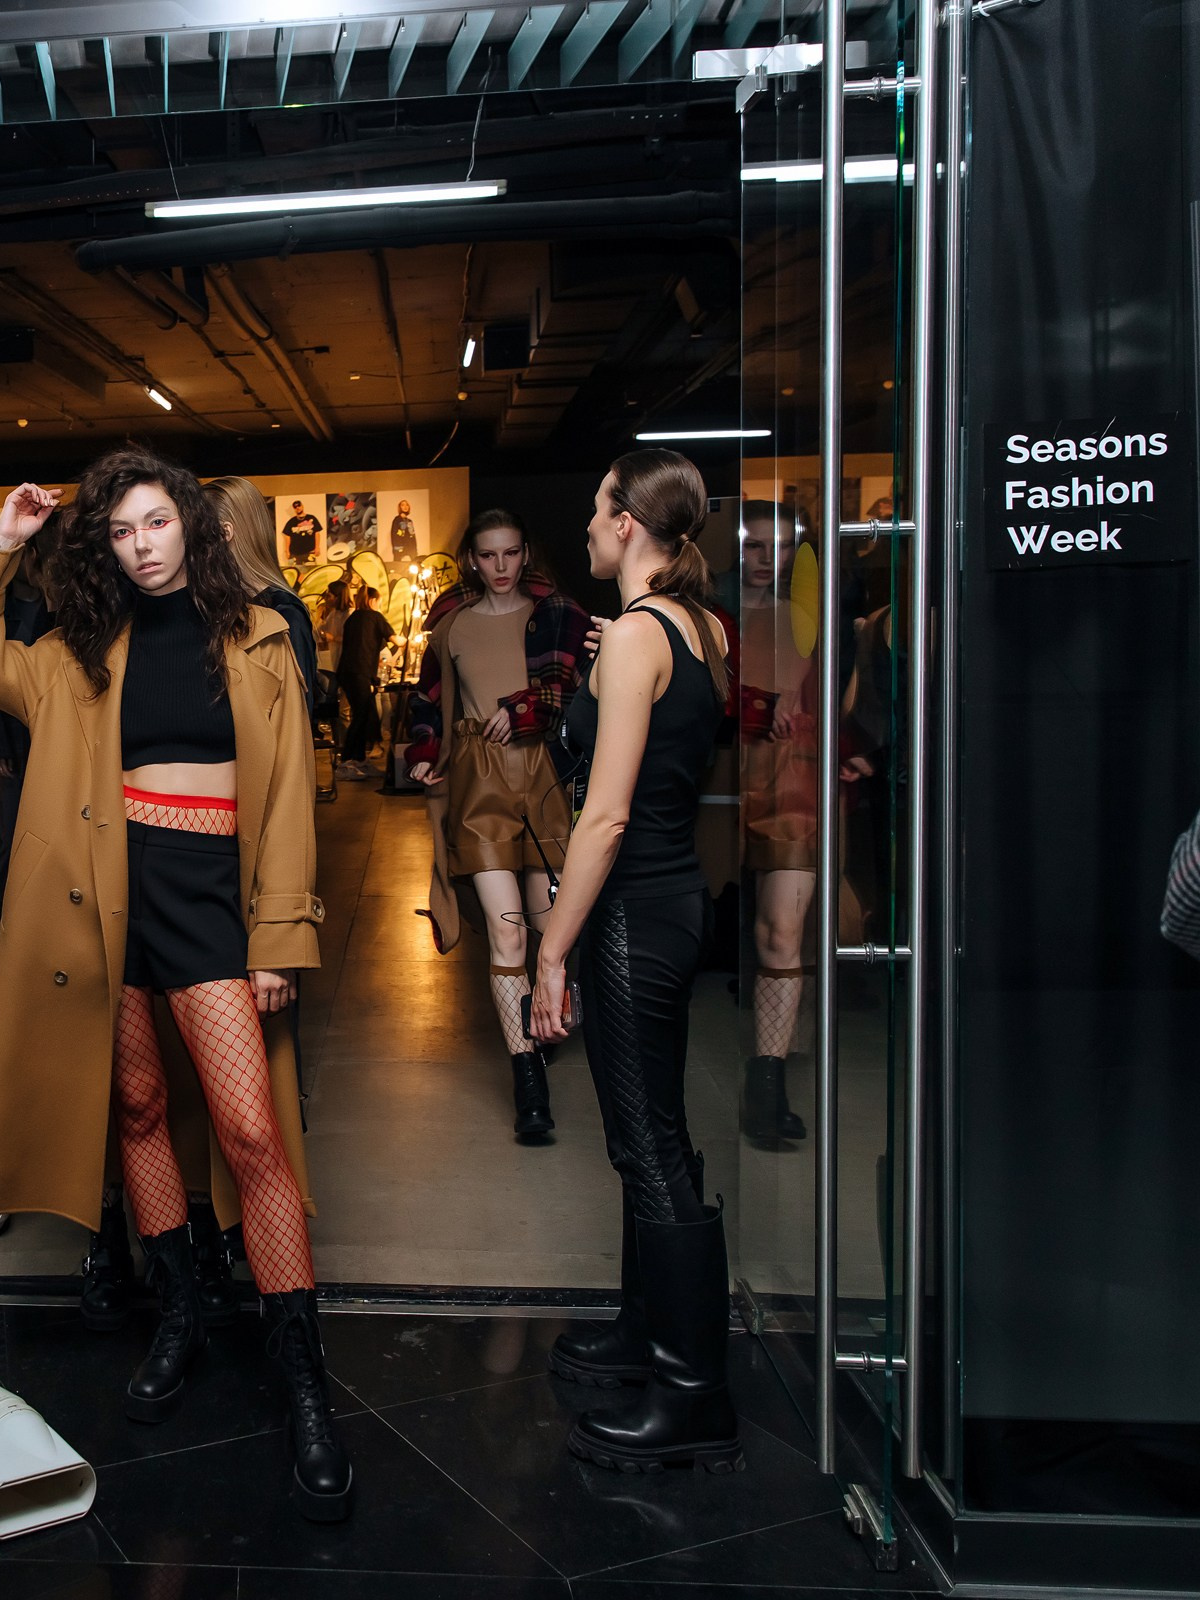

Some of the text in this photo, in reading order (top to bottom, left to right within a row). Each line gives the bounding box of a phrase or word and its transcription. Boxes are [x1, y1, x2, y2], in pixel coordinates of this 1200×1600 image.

[1006, 432, 1168, 464] Seasons
[1005, 475, 1154, 510] Fashion
[1006, 521, 1123, 555] Week
